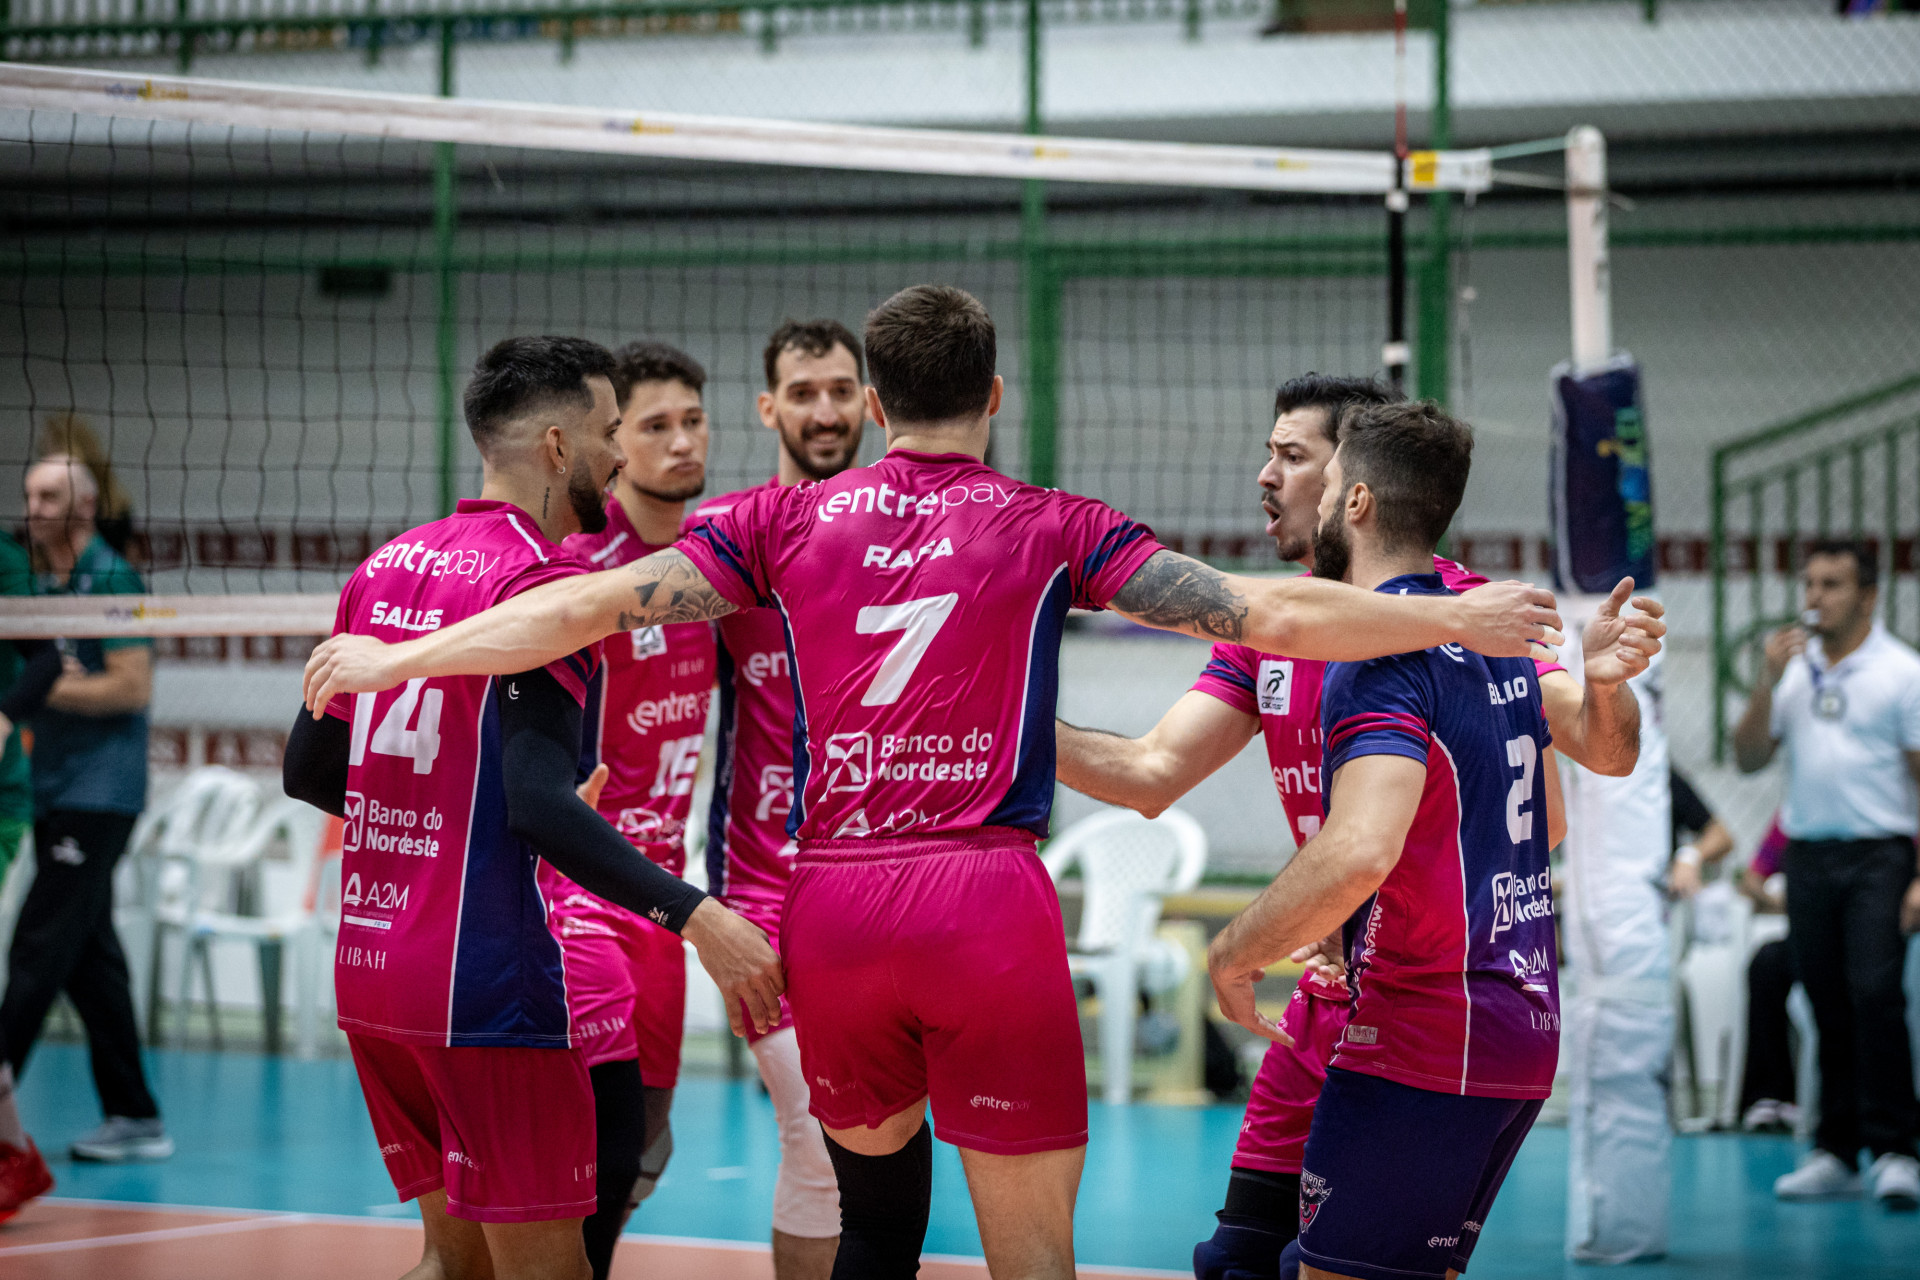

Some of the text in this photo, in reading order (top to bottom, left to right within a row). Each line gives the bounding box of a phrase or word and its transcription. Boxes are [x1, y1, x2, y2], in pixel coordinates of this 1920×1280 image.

[817, 483, 1020, 523] entrepay
[366, 540, 500, 584] entrepay
[862, 537, 954, 569] RAFA
[370, 601, 444, 631] SALLES
[855, 592, 959, 707] 7
[348, 677, 444, 775] 14
[880, 727, 993, 759] Banco do
[877, 757, 989, 782] Nordeste
[1505, 734, 1537, 845] 2
[368, 800, 443, 831] Banco do
[366, 827, 440, 858] Nordeste
[364, 881, 410, 911] A2M
[339, 945, 387, 971] LIBAH
